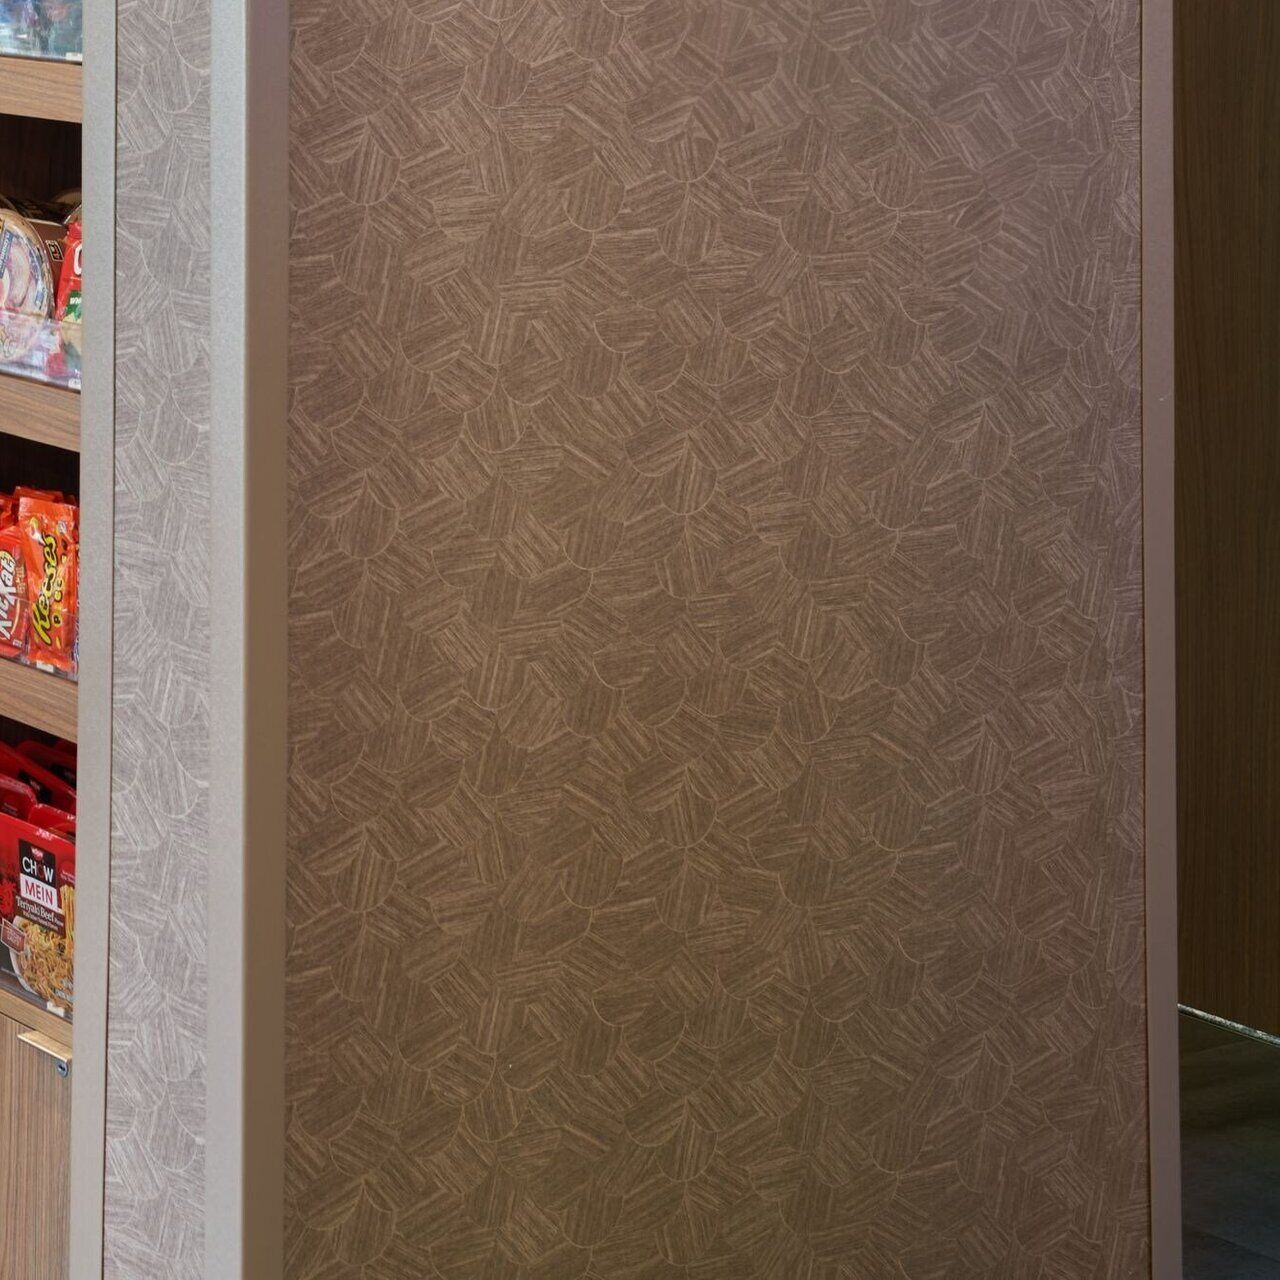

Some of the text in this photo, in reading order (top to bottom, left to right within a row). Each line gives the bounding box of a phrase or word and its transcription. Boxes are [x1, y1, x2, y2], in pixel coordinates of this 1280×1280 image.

[25, 881, 53, 905] MEIN
[16, 895, 54, 921] Teriyaki Beef
